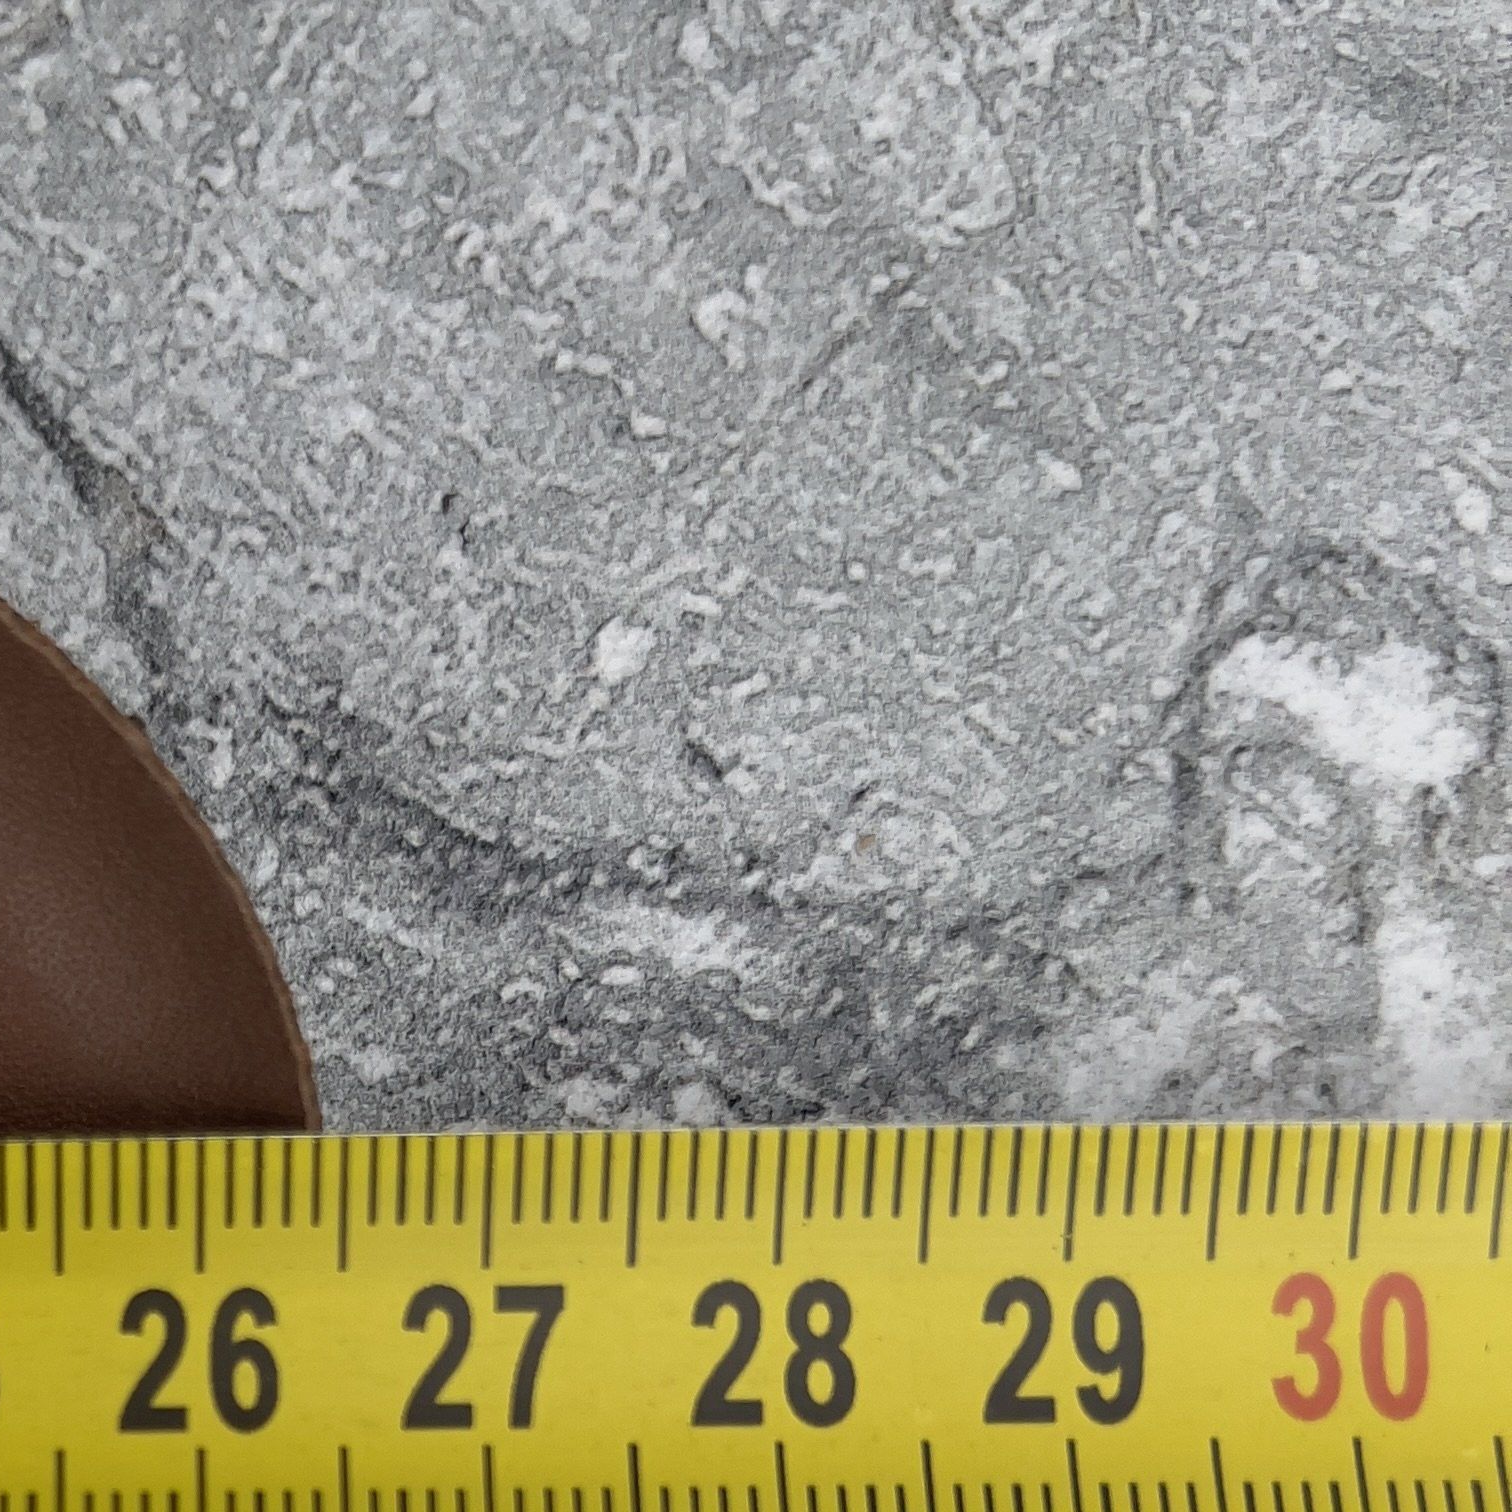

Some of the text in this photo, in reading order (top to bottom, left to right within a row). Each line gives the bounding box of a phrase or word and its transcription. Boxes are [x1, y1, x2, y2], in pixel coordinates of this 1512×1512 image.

[119, 1288, 278, 1433] 26
[403, 1285, 563, 1429] 27
[693, 1279, 855, 1427] 28
[985, 1277, 1144, 1424] 29
[1271, 1271, 1429, 1422] 30
